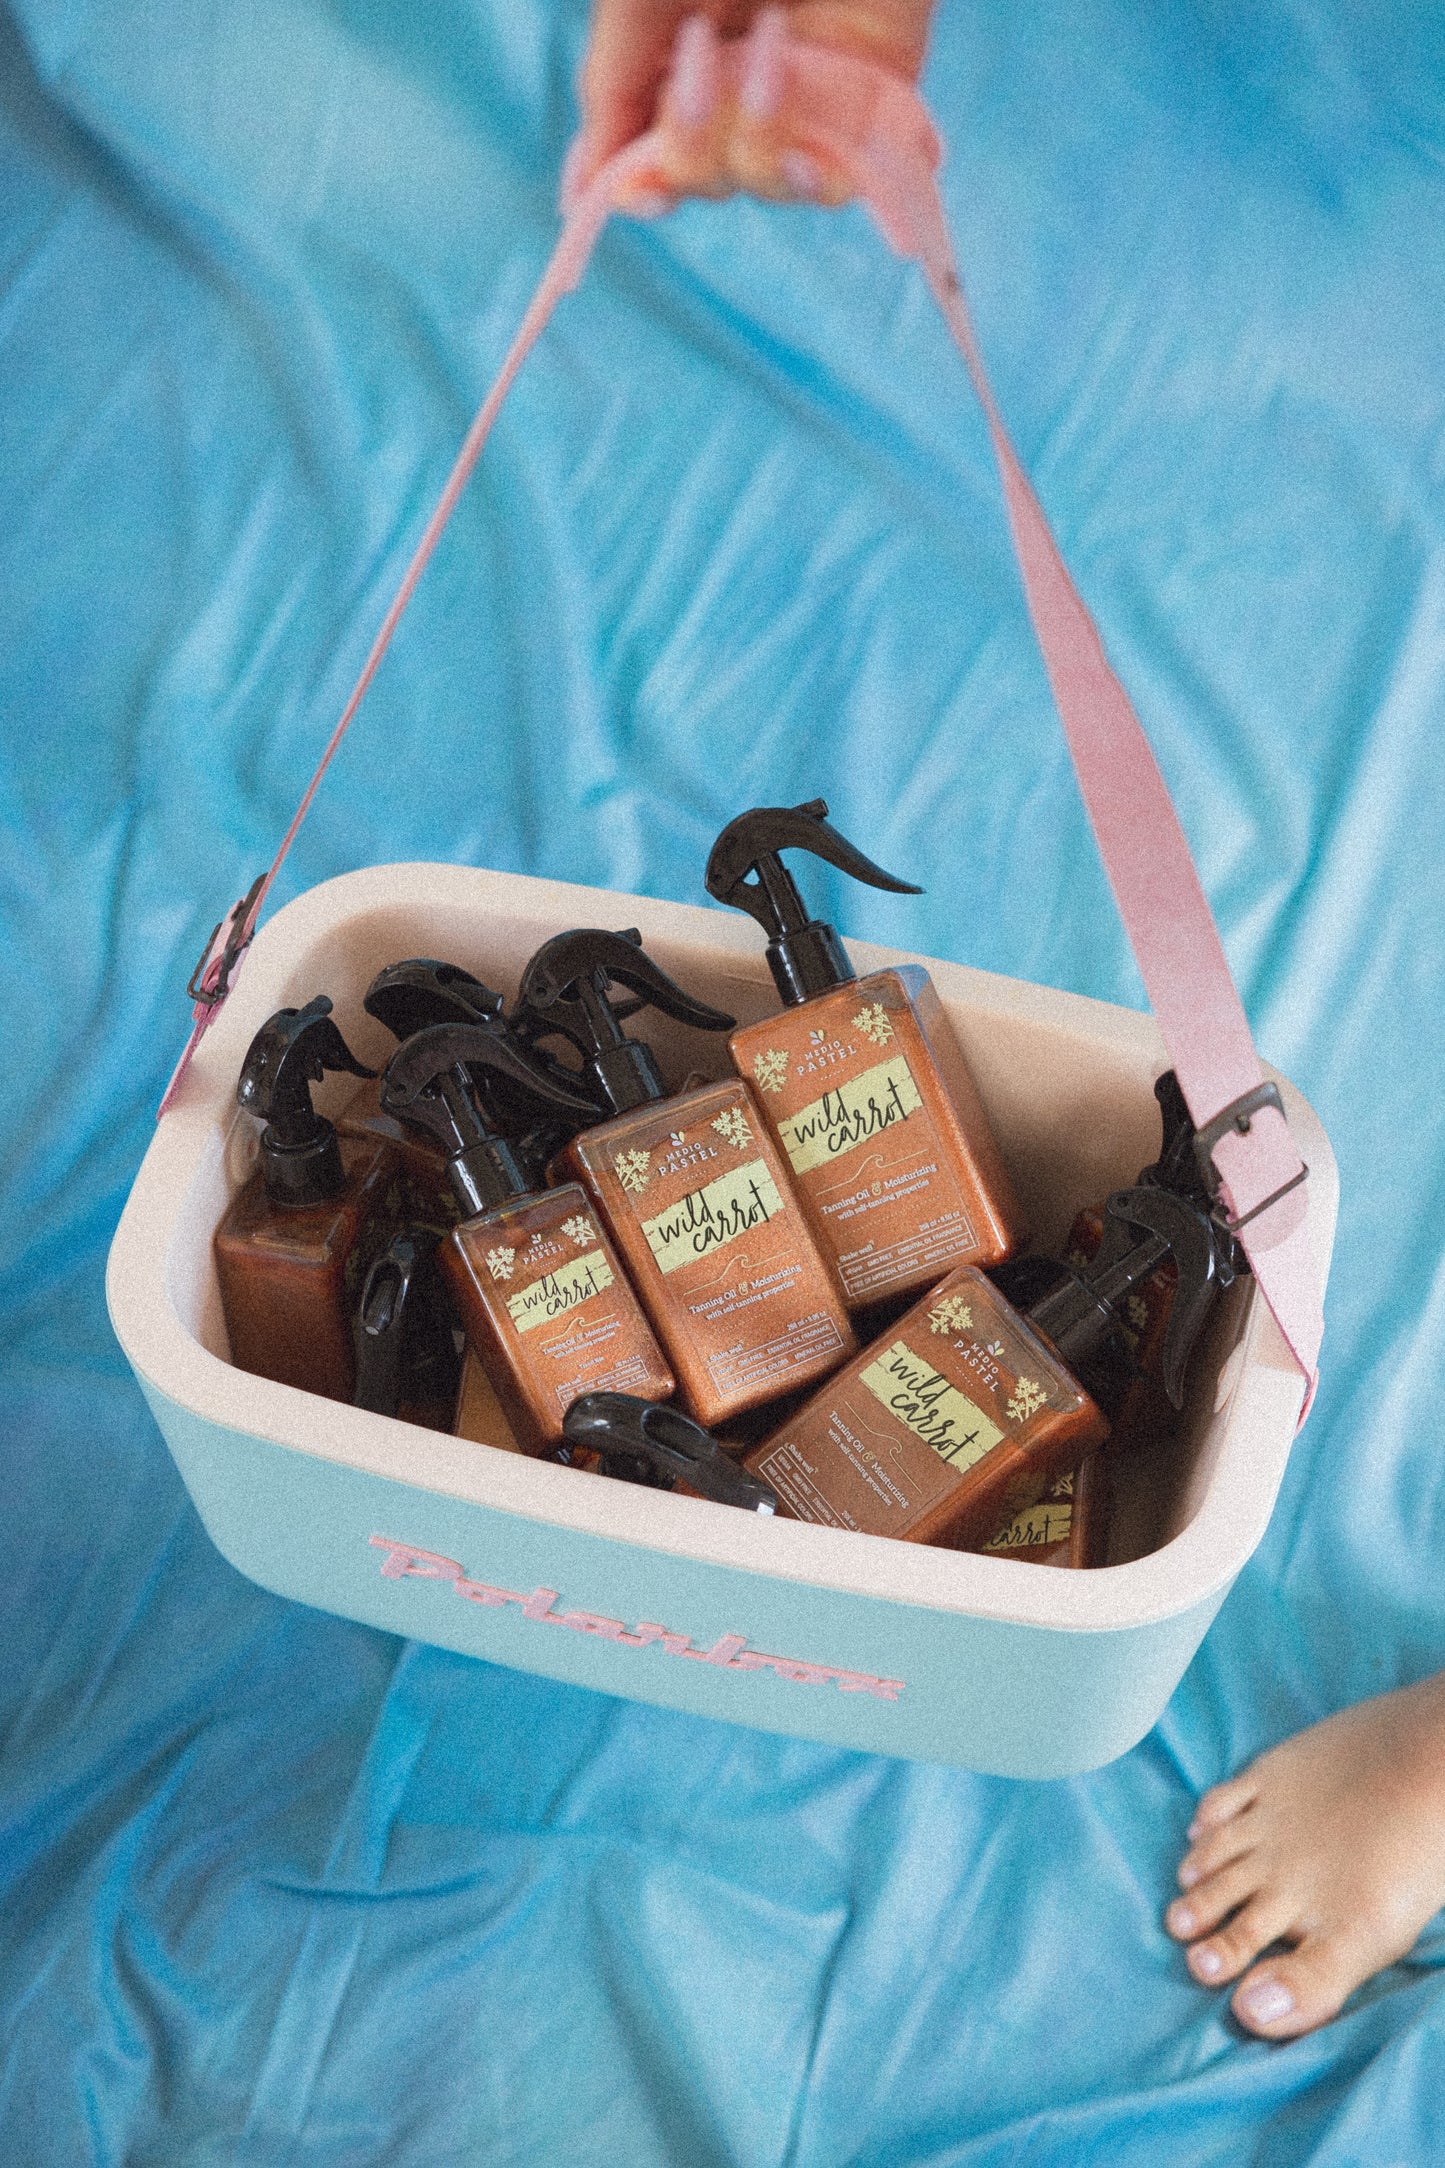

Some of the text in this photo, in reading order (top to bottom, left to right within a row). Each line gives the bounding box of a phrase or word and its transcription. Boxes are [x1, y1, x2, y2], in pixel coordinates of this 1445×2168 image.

[795, 1043, 857, 1076] PASTEL
[803, 1039, 841, 1060] MEDIO
[794, 1088, 849, 1143] wild
[828, 1077, 909, 1151] carrot
[657, 1145, 717, 1177] PASTEL
[664, 1141, 702, 1162] MEDIO
[821, 1194, 857, 1215] Tanning
[854, 1188, 870, 1201] Oil
[883, 1162, 937, 1190] Moisturizing
[836, 1208, 854, 1220] with
[658, 1187, 715, 1243] wild
[693, 1180, 769, 1252] carrot
[522, 1243, 564, 1265] PASTEL
[527, 1240, 553, 1254] MEDIO
[522, 1272, 562, 1310] wild
[546, 1265, 600, 1316] carrot
[688, 1294, 724, 1315] Tanning
[722, 1288, 737, 1300] Oil
[749, 1262, 802, 1290] Moisturizing
[705, 1308, 723, 1320] with
[889, 1356, 952, 1403] wild
[953, 1338, 1000, 1393] PASTEL
[970, 1341, 999, 1376] MEDIO
[890, 1393, 980, 1465] carrot
[826, 1427, 842, 1444] with
[865, 1474, 893, 1507] properties
[827, 1409, 855, 1442] Tanning
[851, 1438, 865, 1452] Oil
[870, 1461, 910, 1509] Moisturizing
[368, 1535, 905, 1701] Polarbox
